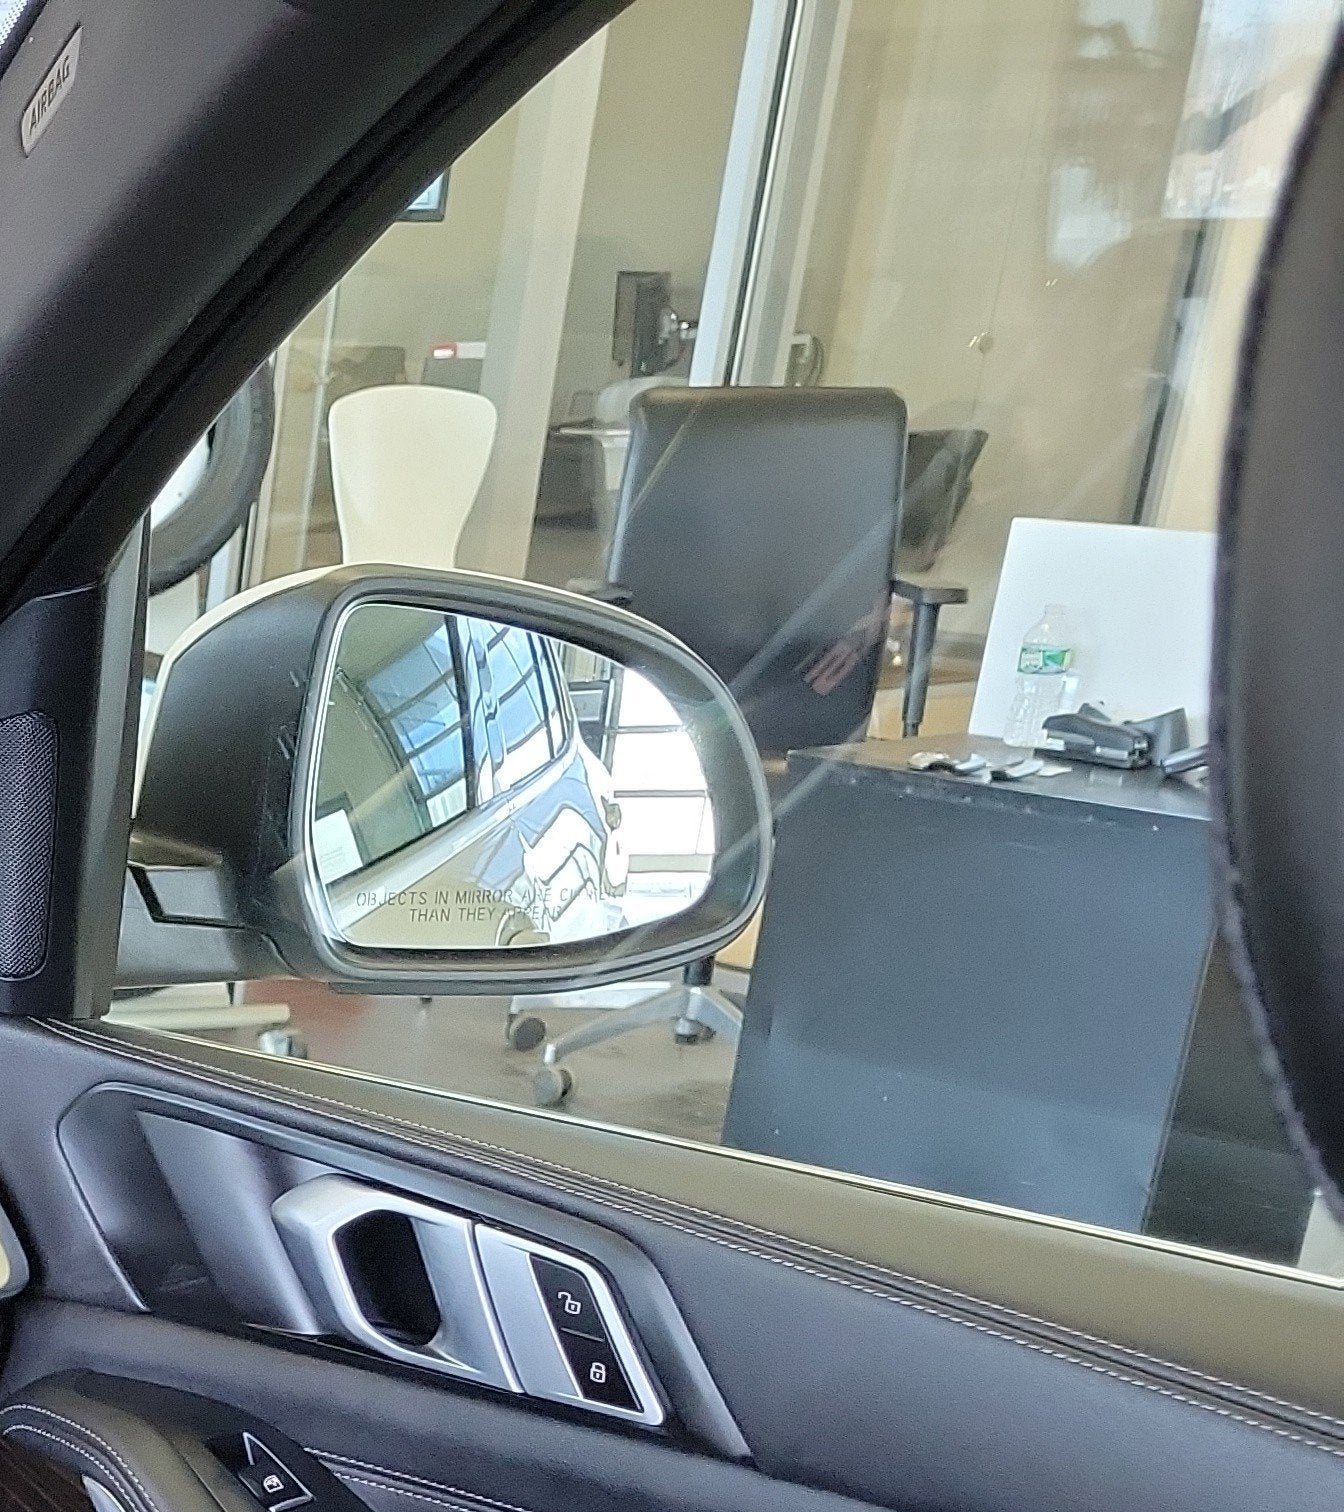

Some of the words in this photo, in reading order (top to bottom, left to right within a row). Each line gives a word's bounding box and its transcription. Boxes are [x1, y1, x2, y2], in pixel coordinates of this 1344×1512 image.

[30, 54, 70, 136] AIRBAG
[356, 891, 428, 907] OBJECTS
[435, 889, 449, 905] IN
[455, 889, 513, 905] MIRROR
[410, 908, 451, 922] THAN
[458, 907, 497, 921] THEY
